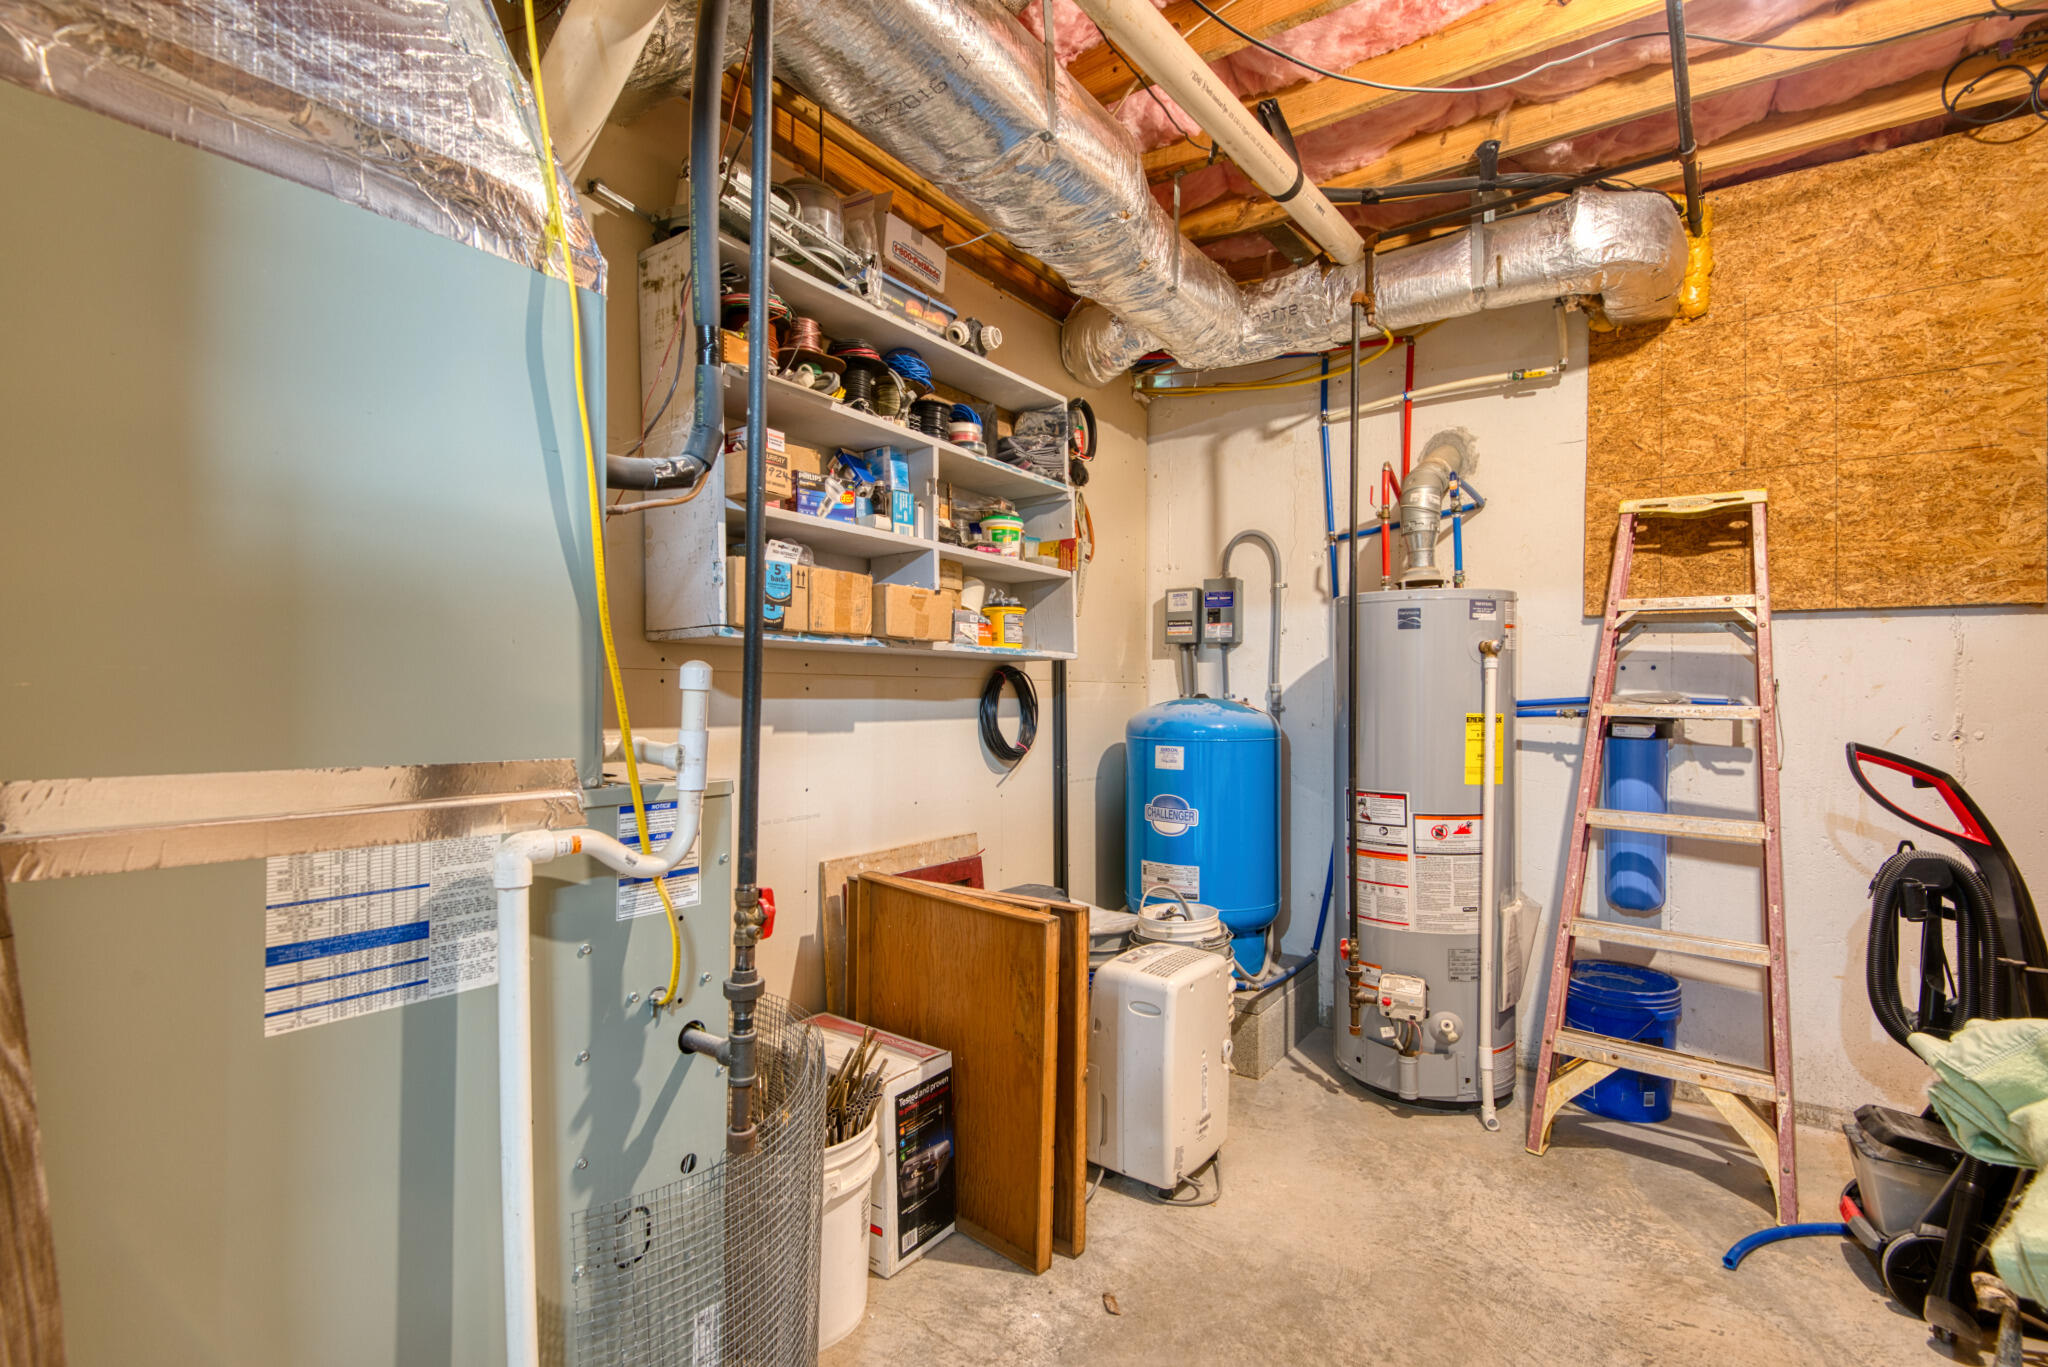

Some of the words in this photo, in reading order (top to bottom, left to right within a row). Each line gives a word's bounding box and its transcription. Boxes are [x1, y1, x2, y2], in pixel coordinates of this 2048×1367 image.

[798, 471, 822, 482] PHILIPS
[770, 575, 786, 583] back
[1146, 806, 1195, 822] CHALLENGER
[899, 1091, 918, 1107] Tested
[919, 1085, 930, 1096] and
[930, 1076, 949, 1093] proven
